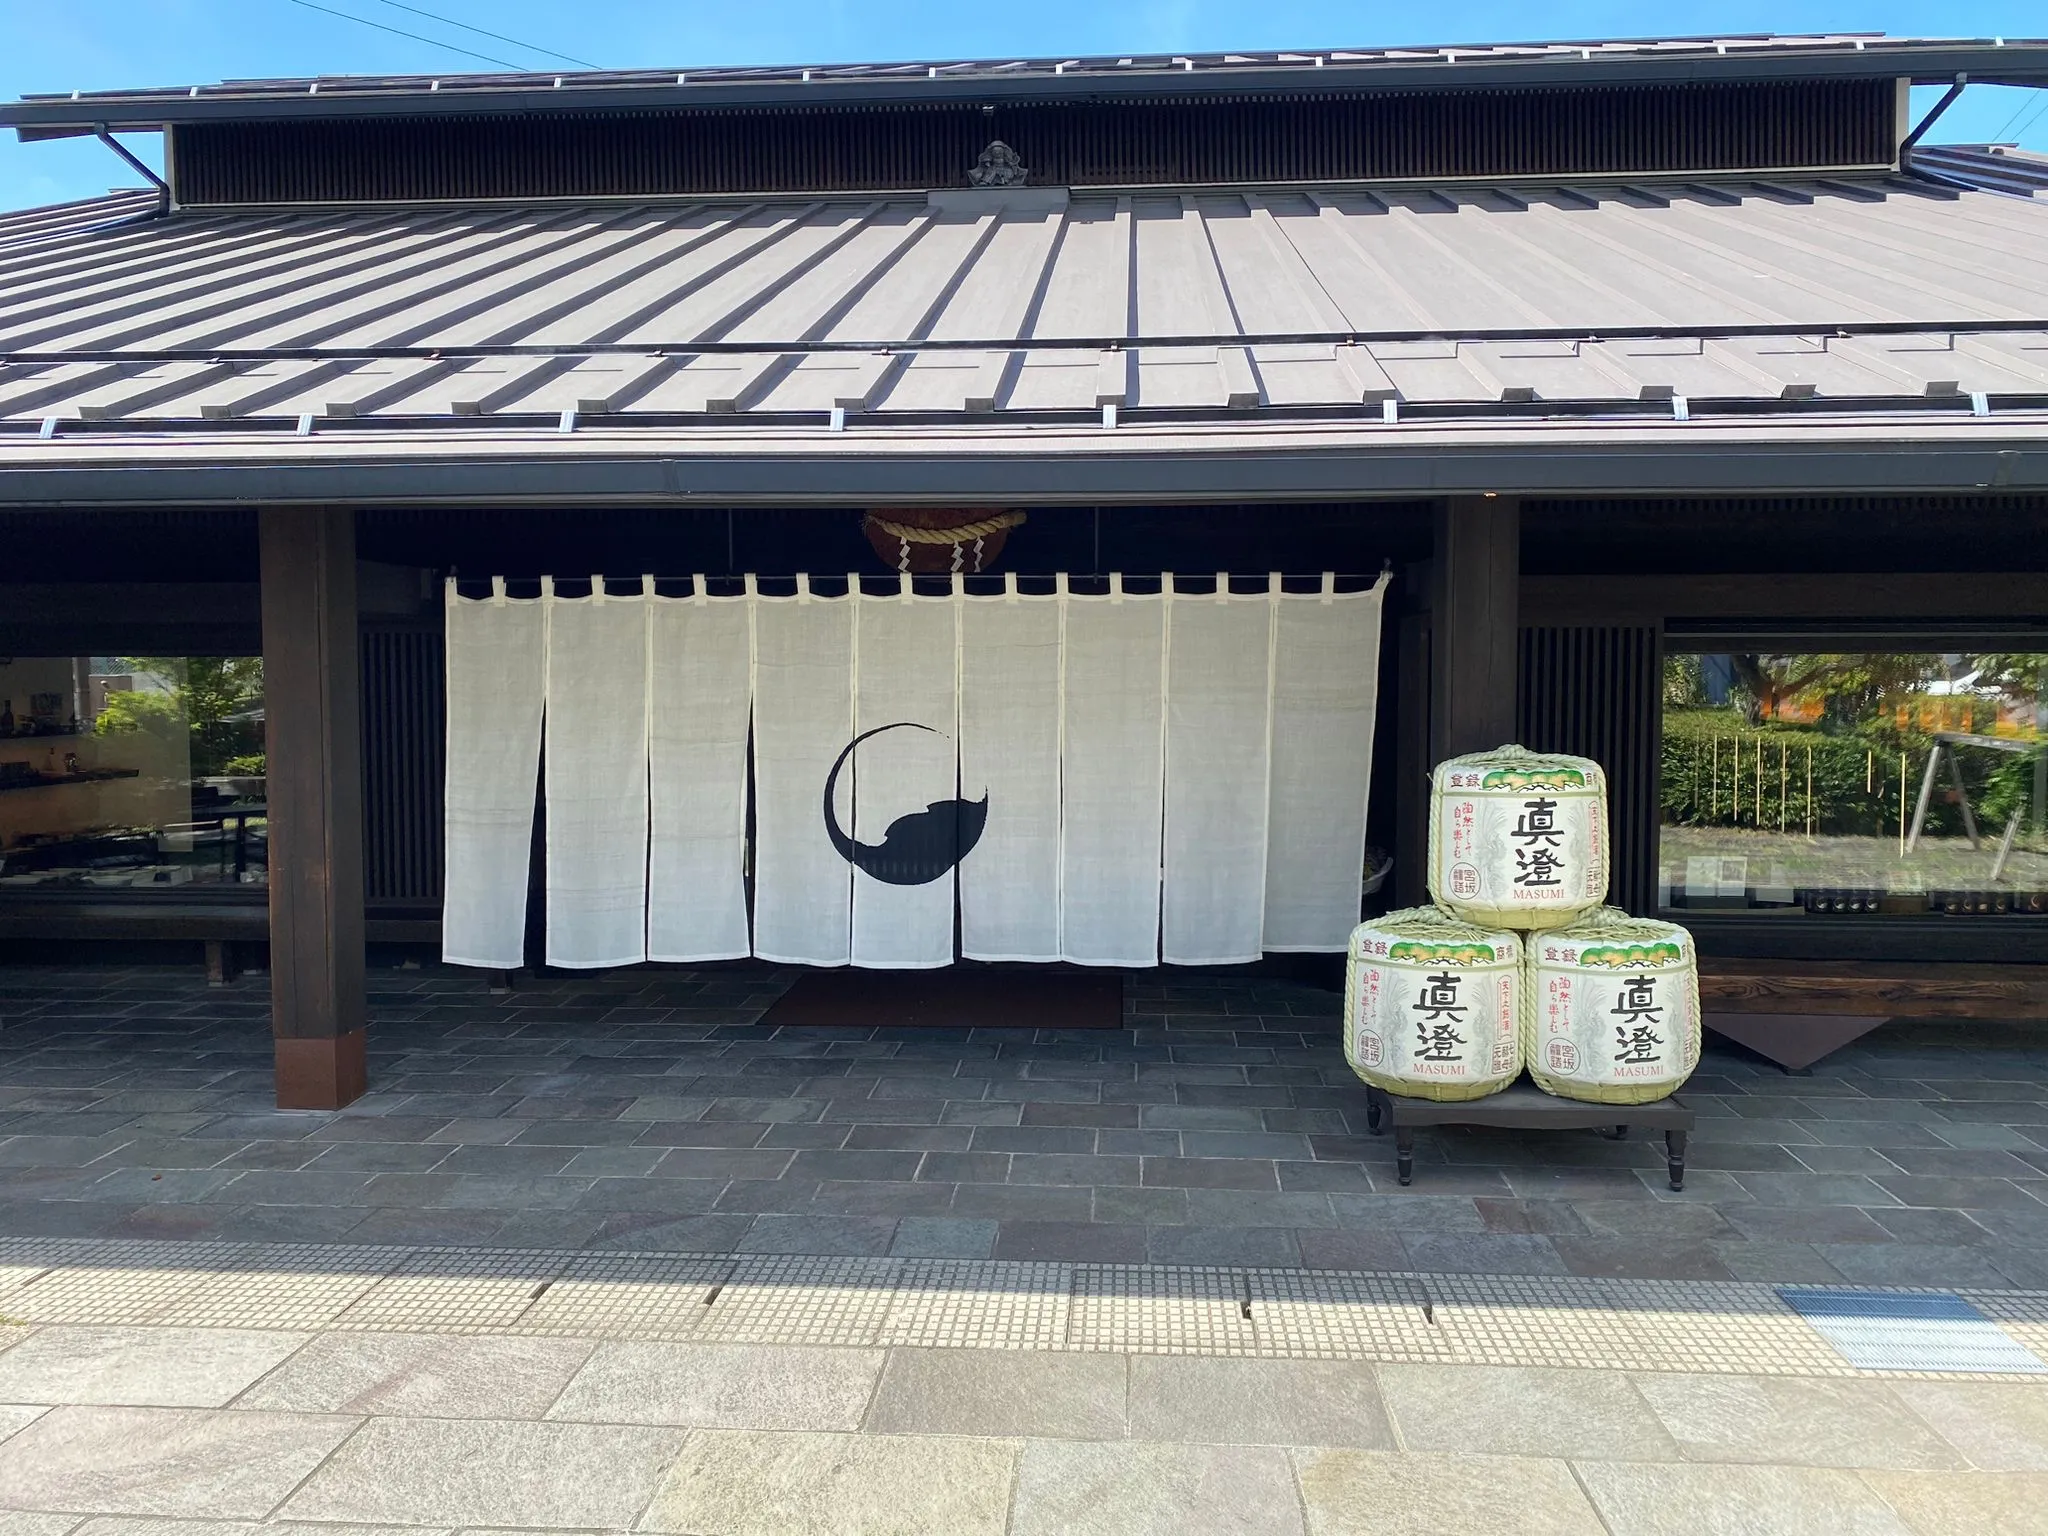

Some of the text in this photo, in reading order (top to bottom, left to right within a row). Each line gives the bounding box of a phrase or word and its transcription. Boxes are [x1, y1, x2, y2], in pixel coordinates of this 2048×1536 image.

[1510, 797, 1565, 886] 真澄
[1513, 889, 1565, 899] MASUMI
[1412, 971, 1468, 1061] 真澄
[1610, 975, 1665, 1065] 真澄
[1413, 1063, 1466, 1075] MASUMI
[1613, 1066, 1664, 1077] MASUMI
